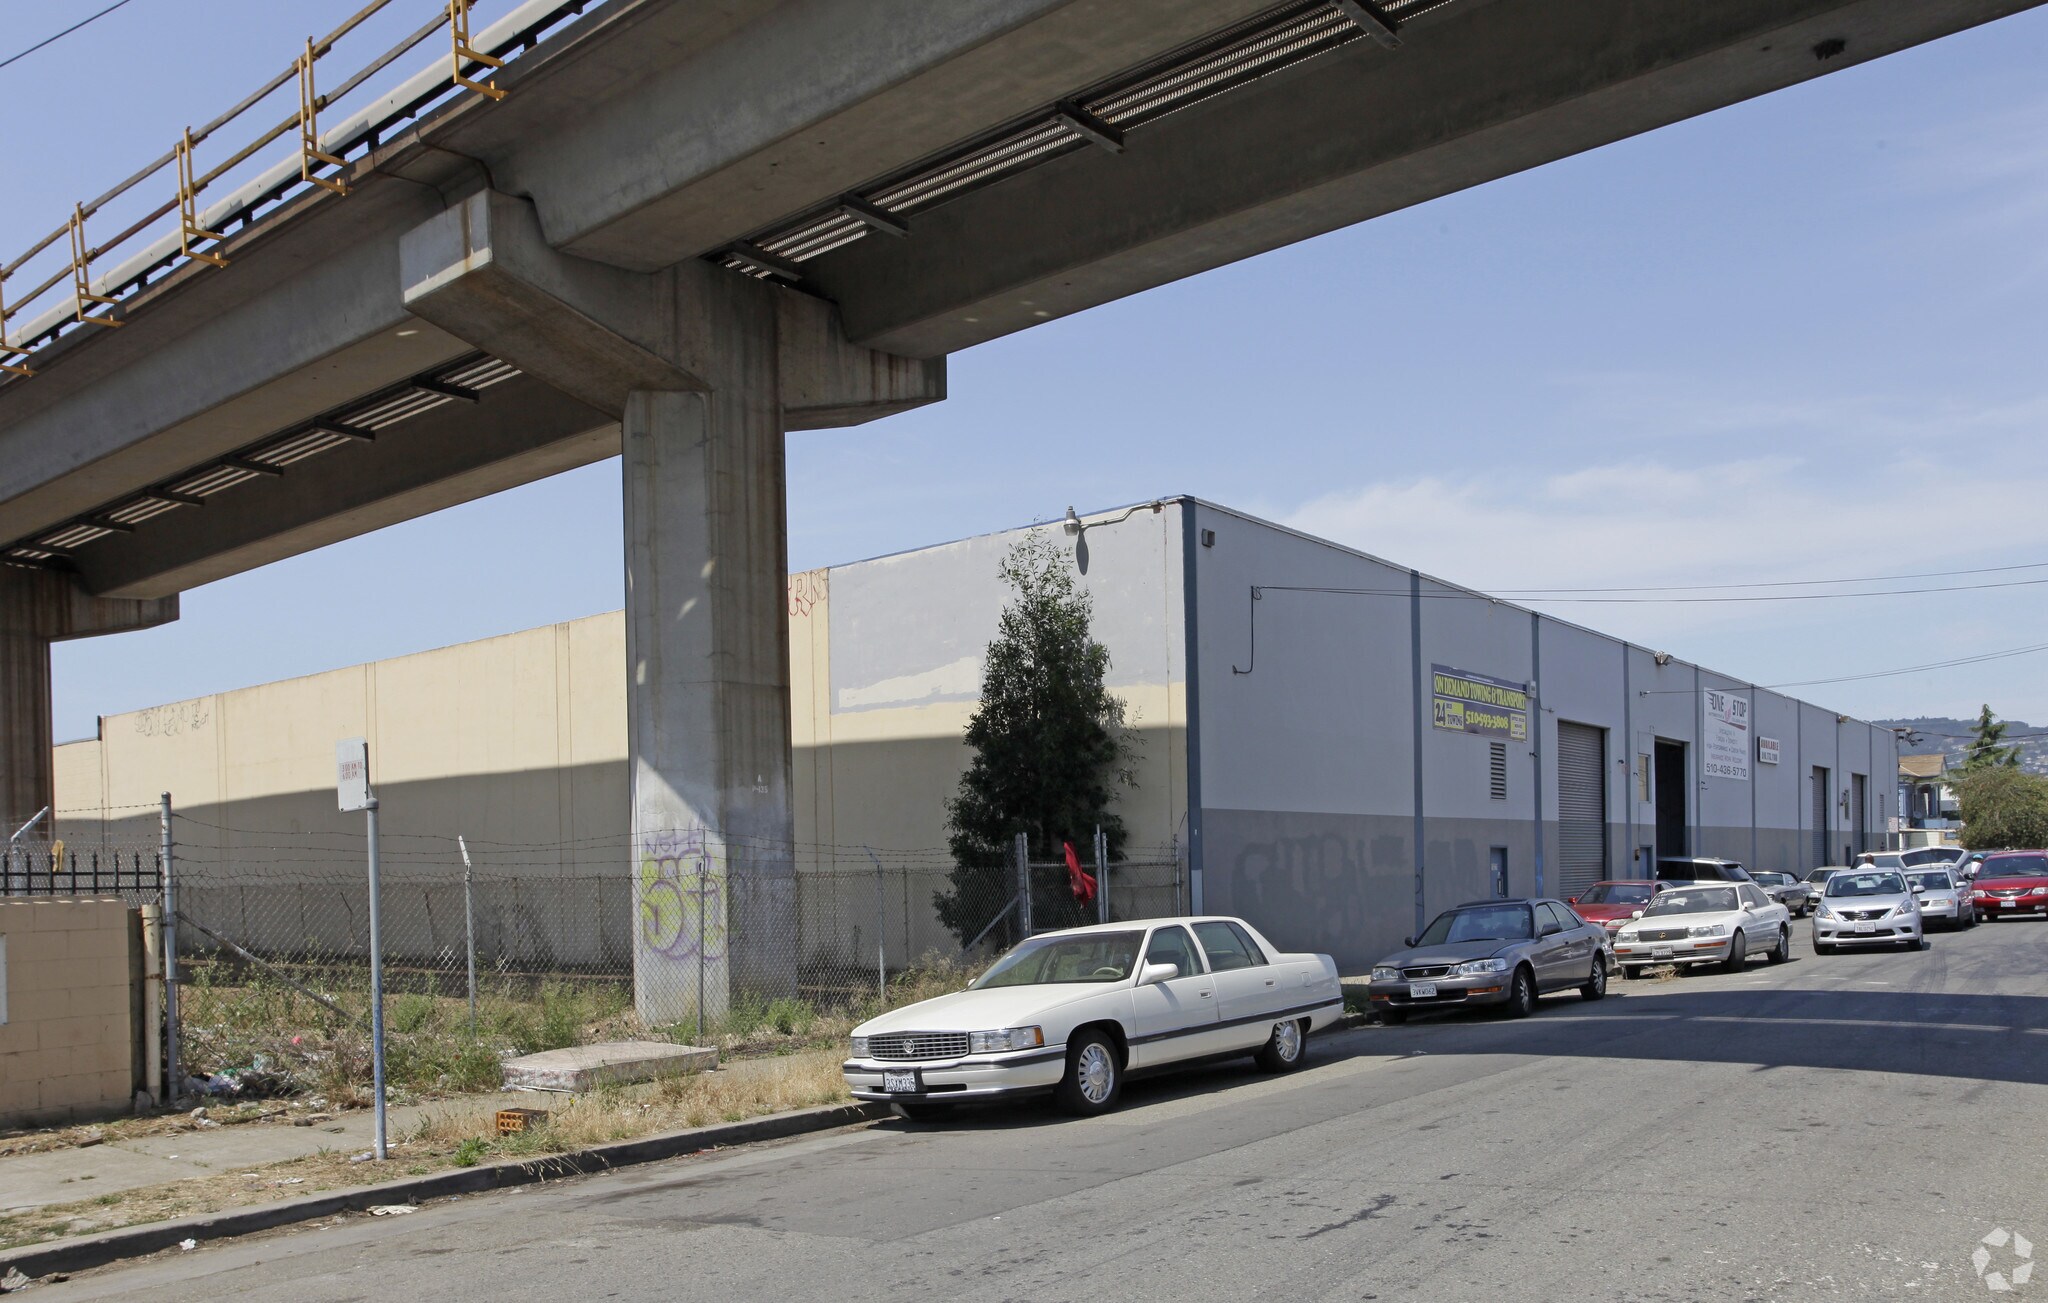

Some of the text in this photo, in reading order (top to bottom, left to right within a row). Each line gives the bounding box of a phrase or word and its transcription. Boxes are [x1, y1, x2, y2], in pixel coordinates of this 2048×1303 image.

[1435, 675, 1444, 694] ON
[1444, 678, 1470, 698] DEMAND
[1470, 684, 1492, 702] TOWING
[1492, 688, 1496, 704] &
[1496, 690, 1526, 709] TRANSPORT
[1436, 702, 1446, 726] 24
[1709, 692, 1724, 712] ONE
[1732, 700, 1746, 717] STOP
[1448, 714, 1462, 726] TOWING
